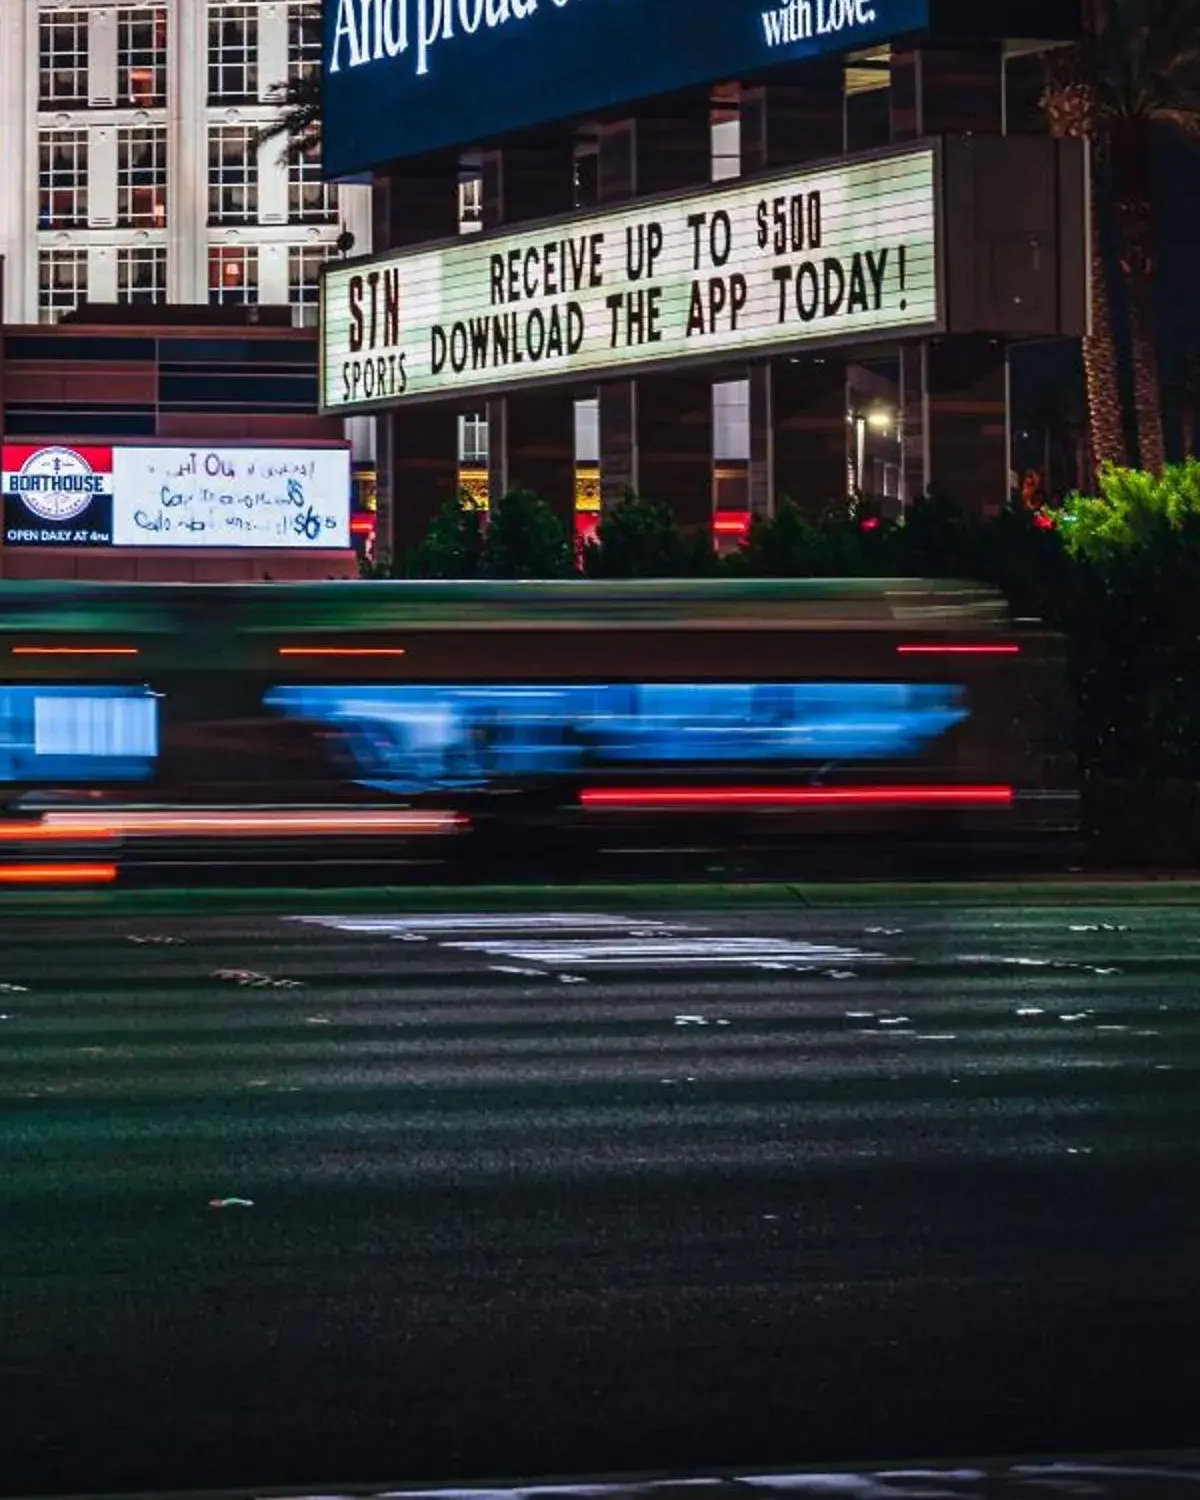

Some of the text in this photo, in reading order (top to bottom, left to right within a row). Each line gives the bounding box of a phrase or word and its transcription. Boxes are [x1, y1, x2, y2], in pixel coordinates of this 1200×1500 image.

[490, 189, 822, 305] RECEIVE UP TO $500
[349, 267, 399, 353] STN
[431, 244, 906, 375] DOWNLOAD THE APP TODAY!
[343, 351, 408, 401] SPORTS
[9, 474, 105, 493] BOATHOUSE
[7, 529, 39, 541] OPEN
[41, 530, 72, 541] DAILY
[73, 530, 88, 541] AT
